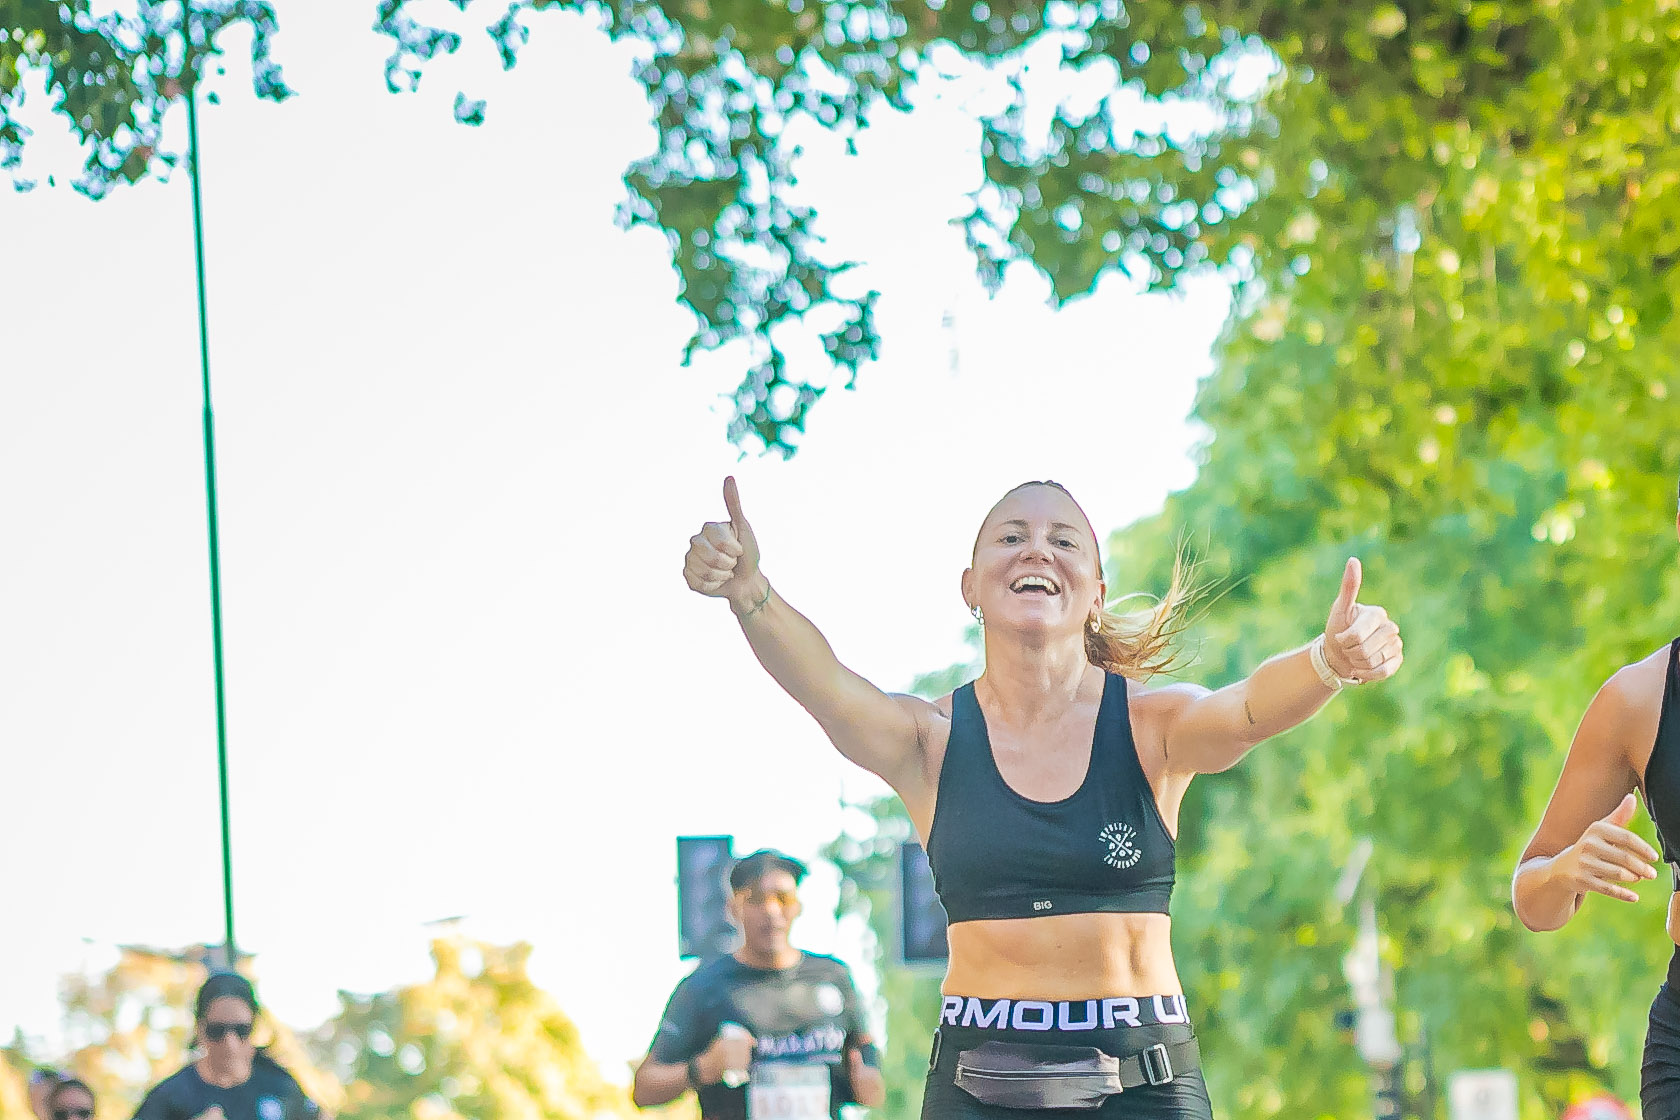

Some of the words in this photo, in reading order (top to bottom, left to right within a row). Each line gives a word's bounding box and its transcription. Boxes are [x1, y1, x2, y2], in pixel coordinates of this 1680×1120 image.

[1033, 900, 1052, 910] BIG
[940, 995, 1142, 1030] RMOUR
[1153, 995, 1190, 1024] U
